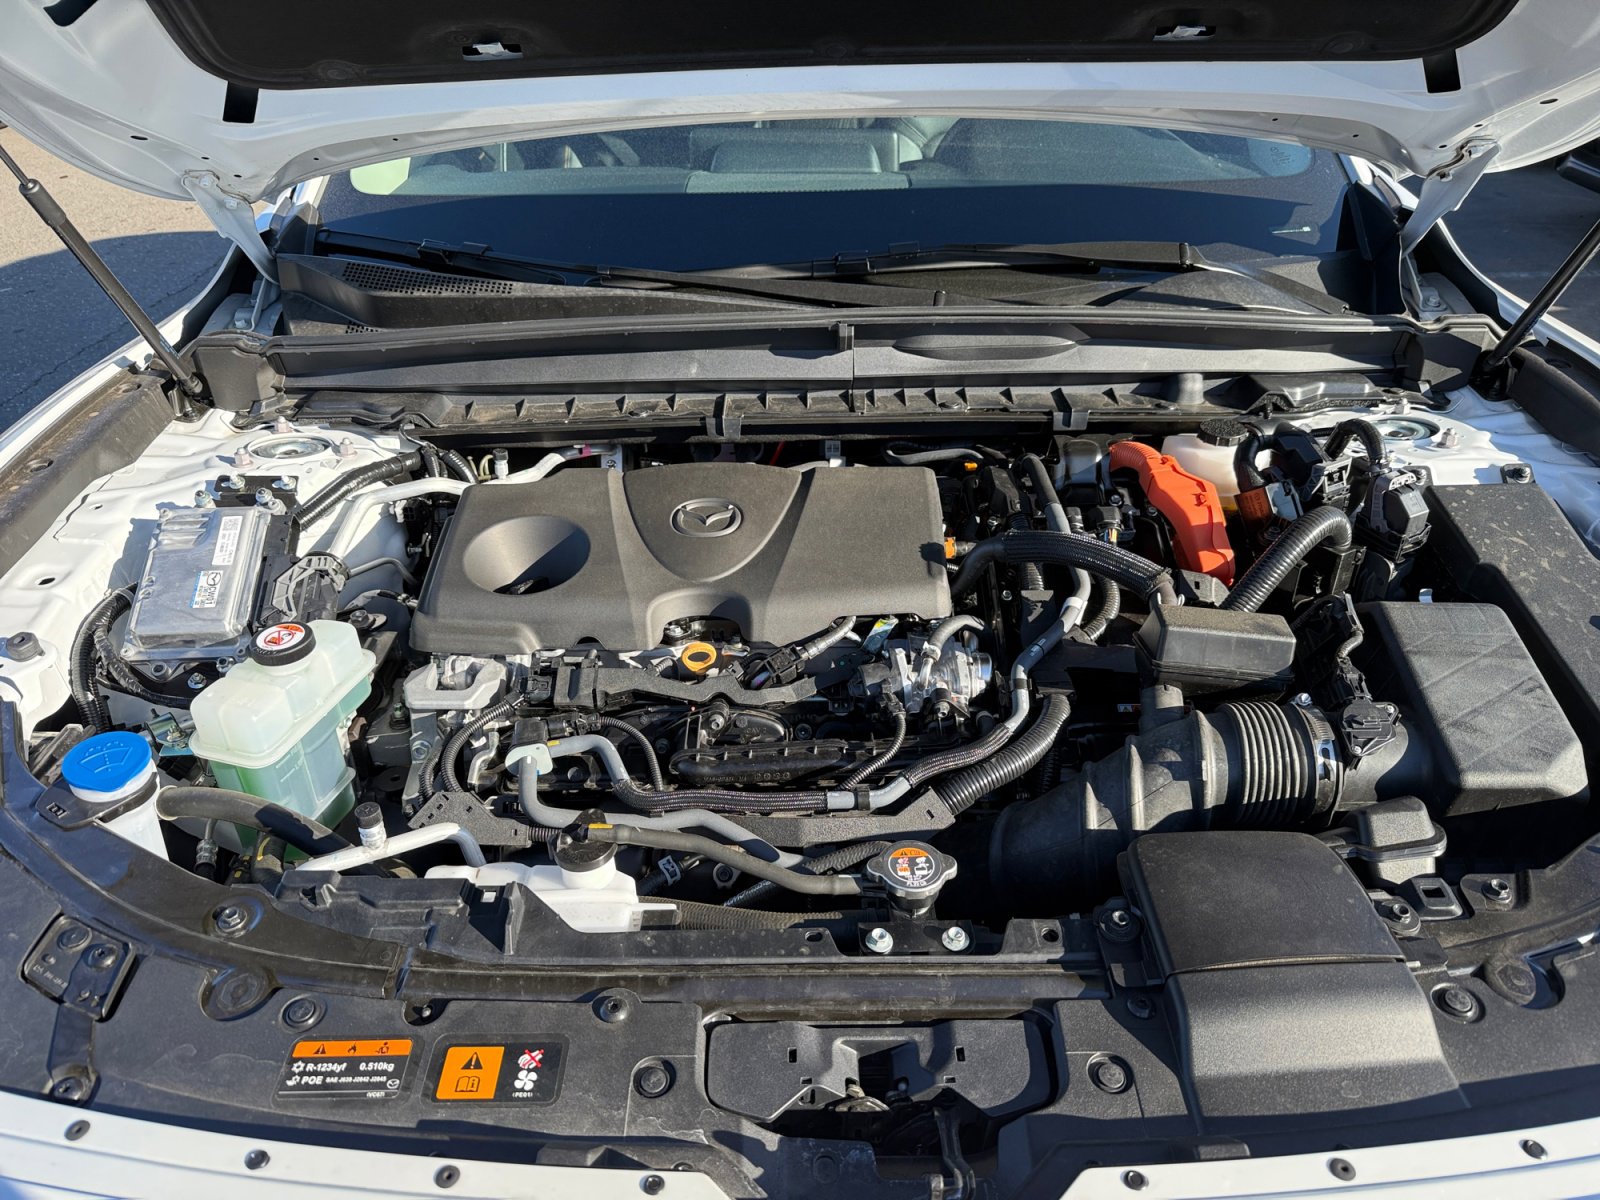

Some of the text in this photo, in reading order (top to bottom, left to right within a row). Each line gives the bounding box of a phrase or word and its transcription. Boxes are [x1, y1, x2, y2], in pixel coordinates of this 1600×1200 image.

[305, 1062, 395, 1073] R-1234yf 0.510kg
[301, 1075, 324, 1085] POE
